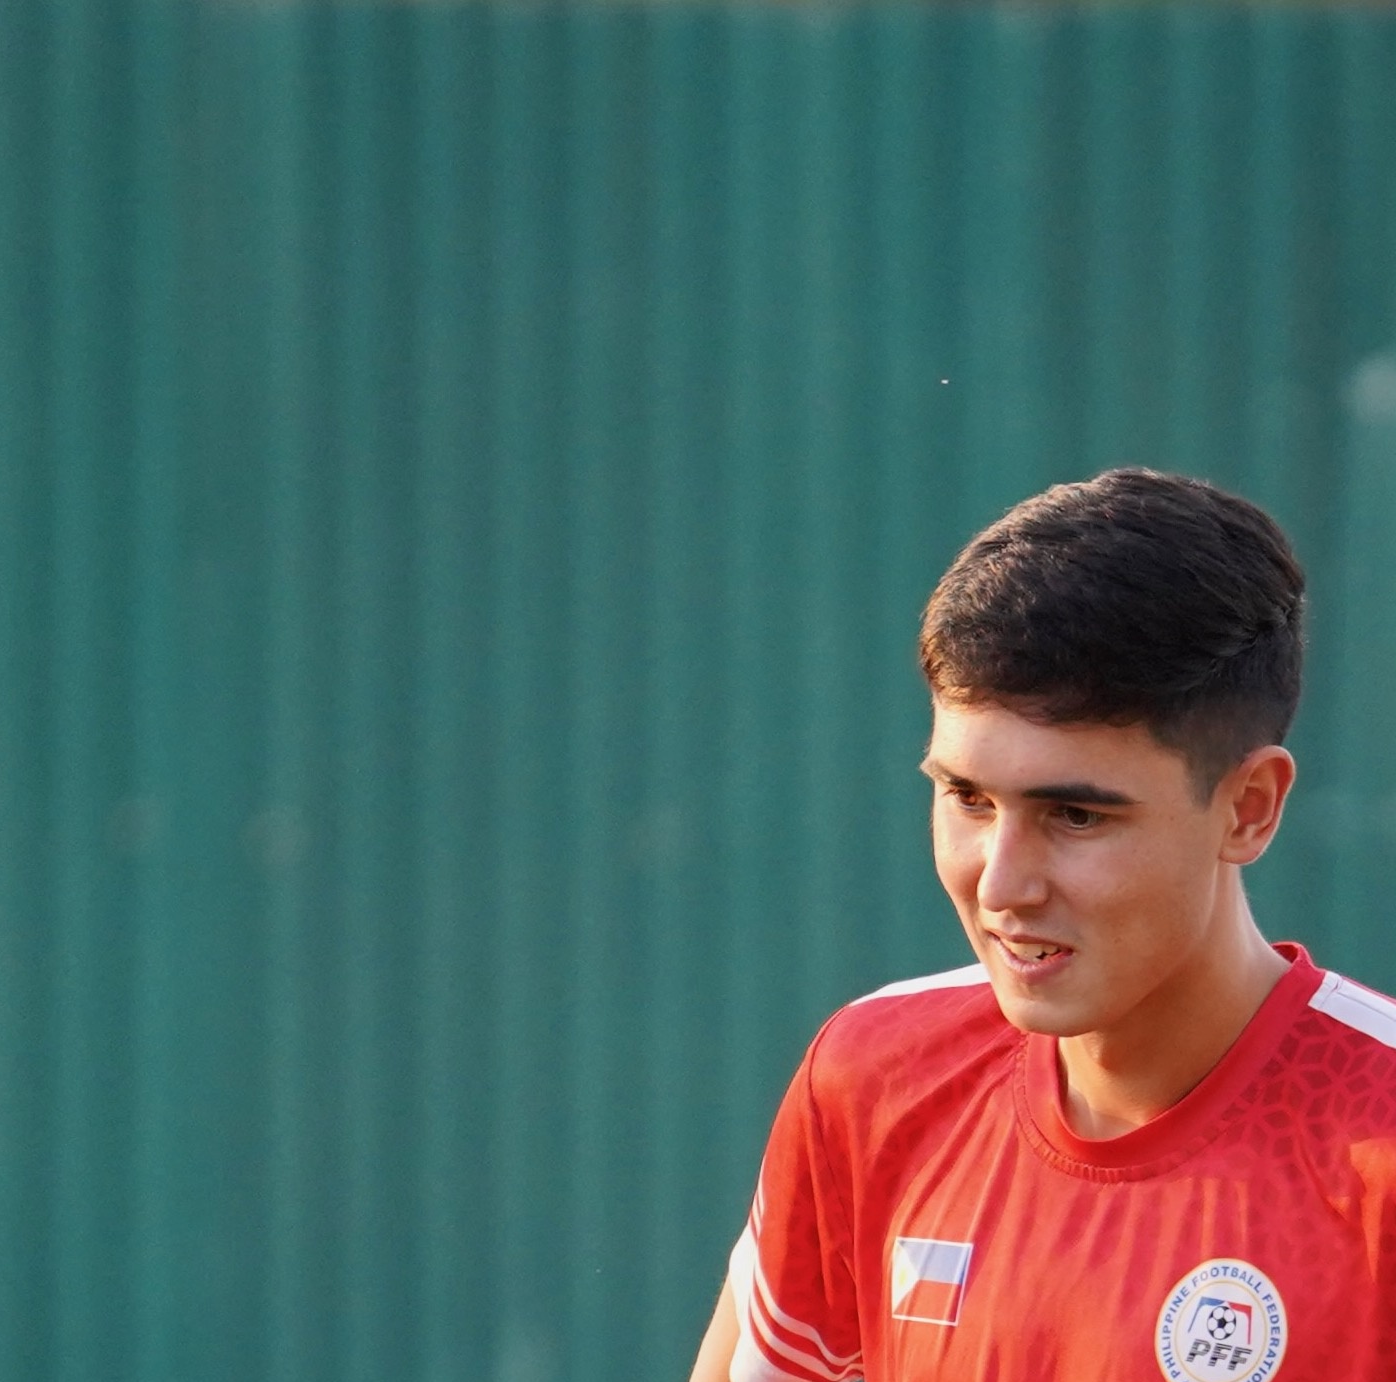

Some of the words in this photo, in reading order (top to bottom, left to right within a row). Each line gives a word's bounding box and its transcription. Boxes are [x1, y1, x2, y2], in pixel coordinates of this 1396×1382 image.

[1161, 1286, 1191, 1380] PHILIPPINE
[1191, 1265, 1263, 1294] FOOTBALL
[1185, 1338, 1253, 1372] PFF
